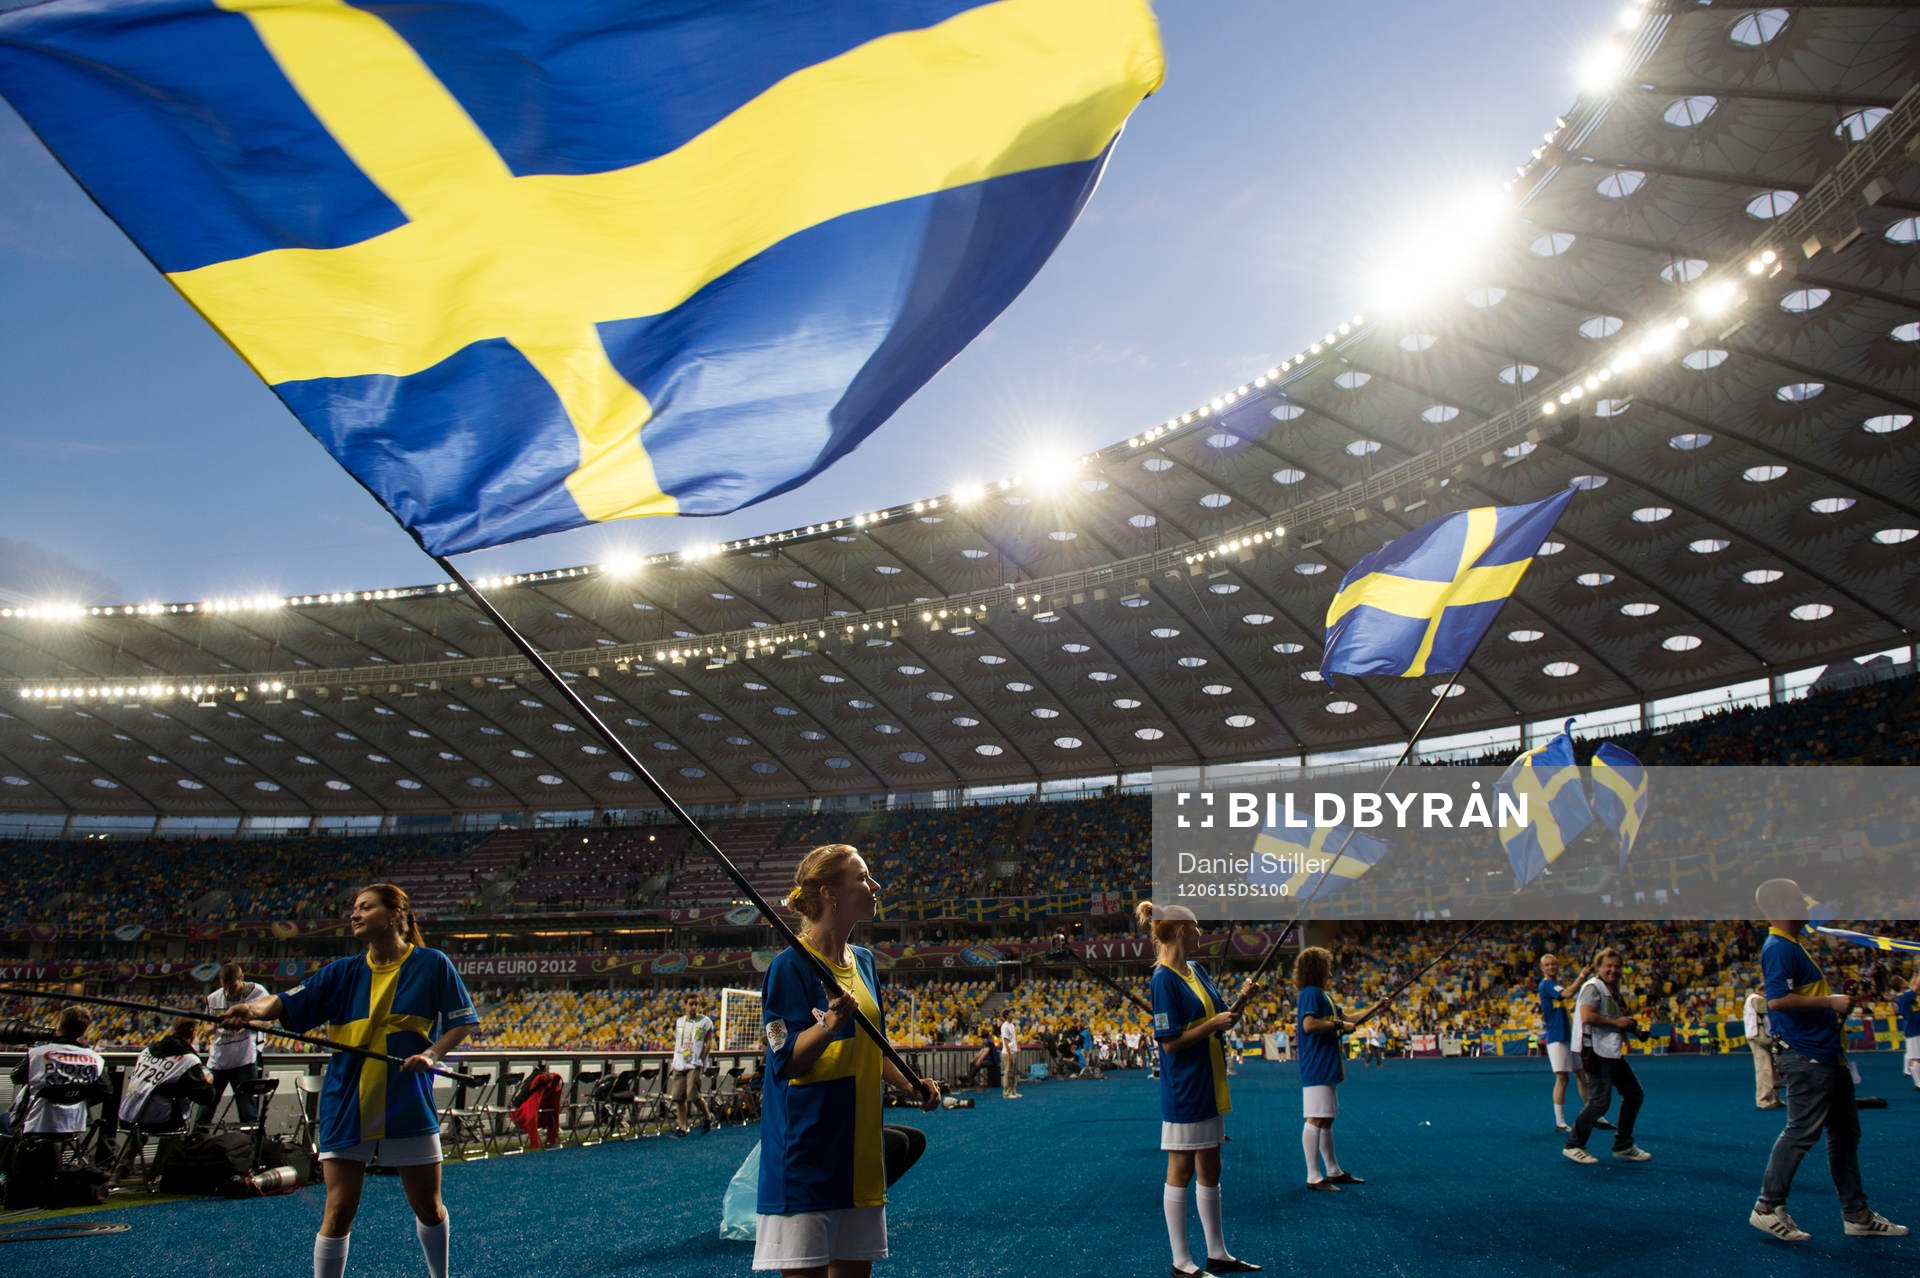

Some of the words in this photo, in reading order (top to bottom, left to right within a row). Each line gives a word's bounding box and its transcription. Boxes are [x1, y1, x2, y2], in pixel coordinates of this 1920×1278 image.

[1085, 942, 1144, 959] KYIV
[458, 961, 495, 975] UEFA
[497, 960, 537, 974] EURO
[539, 960, 577, 973] 2012
[44, 1051, 97, 1064] Canon
